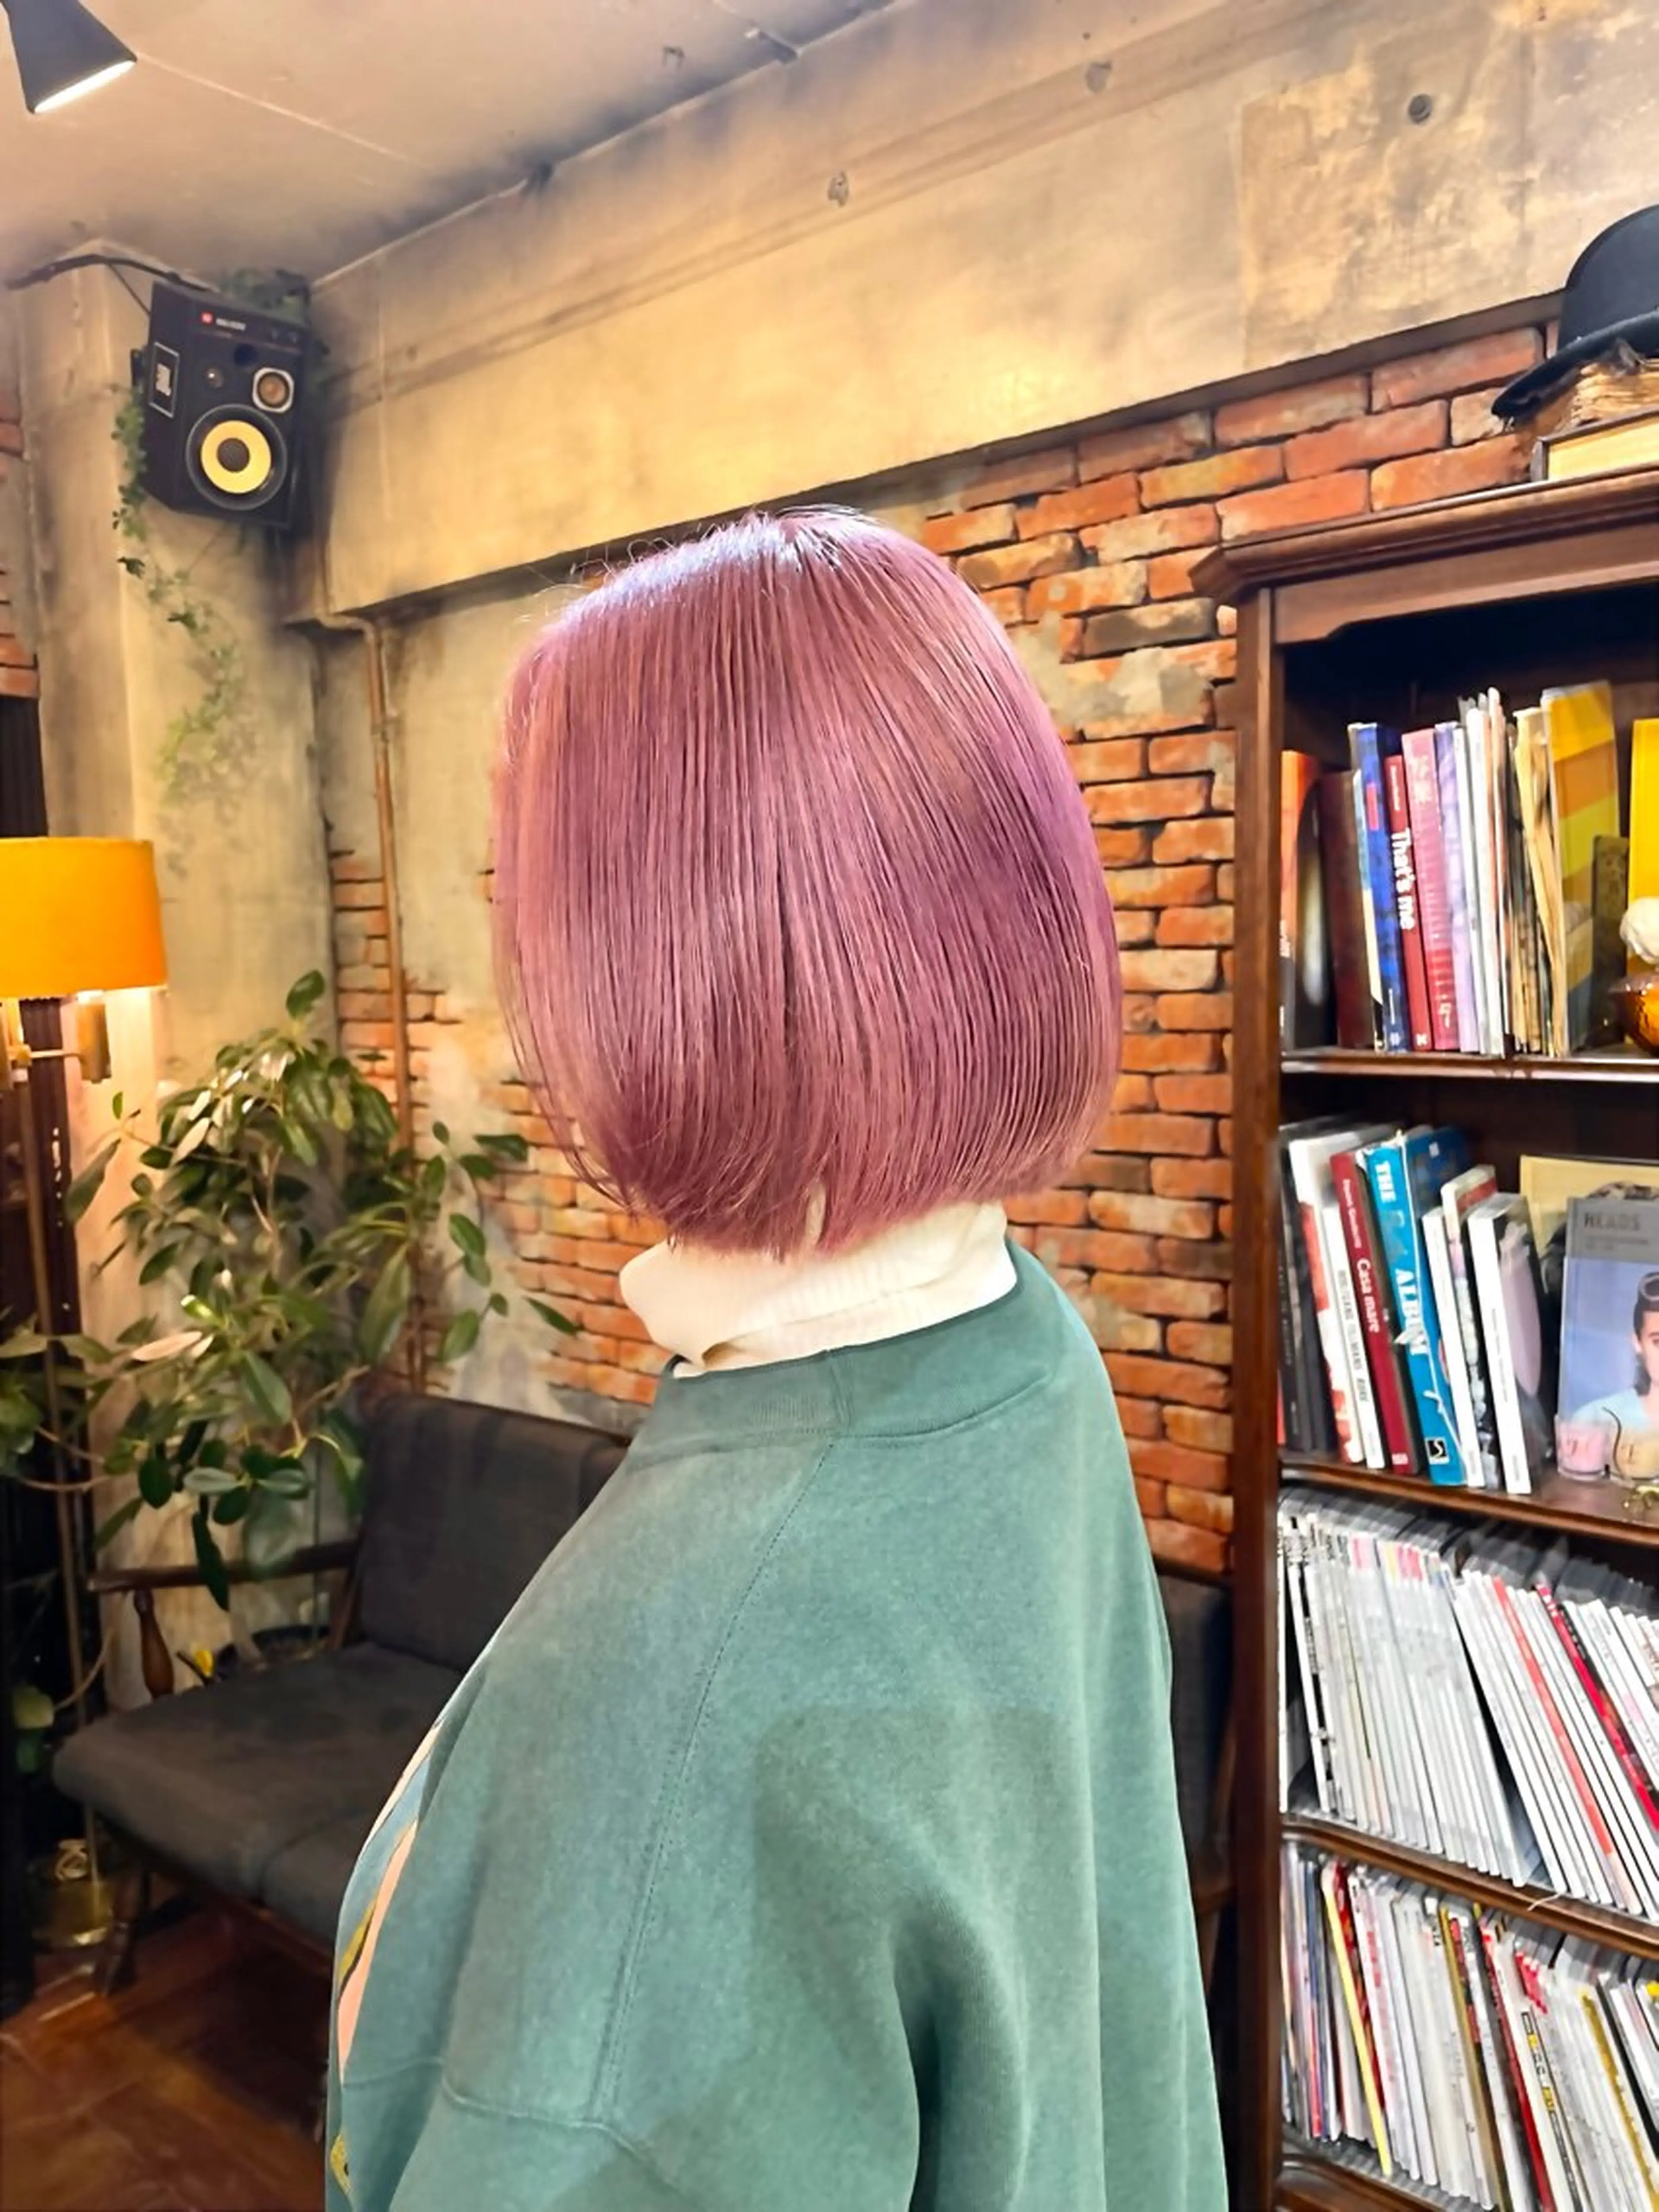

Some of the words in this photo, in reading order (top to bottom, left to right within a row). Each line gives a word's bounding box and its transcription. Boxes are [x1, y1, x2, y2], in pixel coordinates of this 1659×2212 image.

[1391, 828, 1416, 893] That's
[1397, 896, 1415, 930] me
[1375, 1161, 1396, 1202] THE
